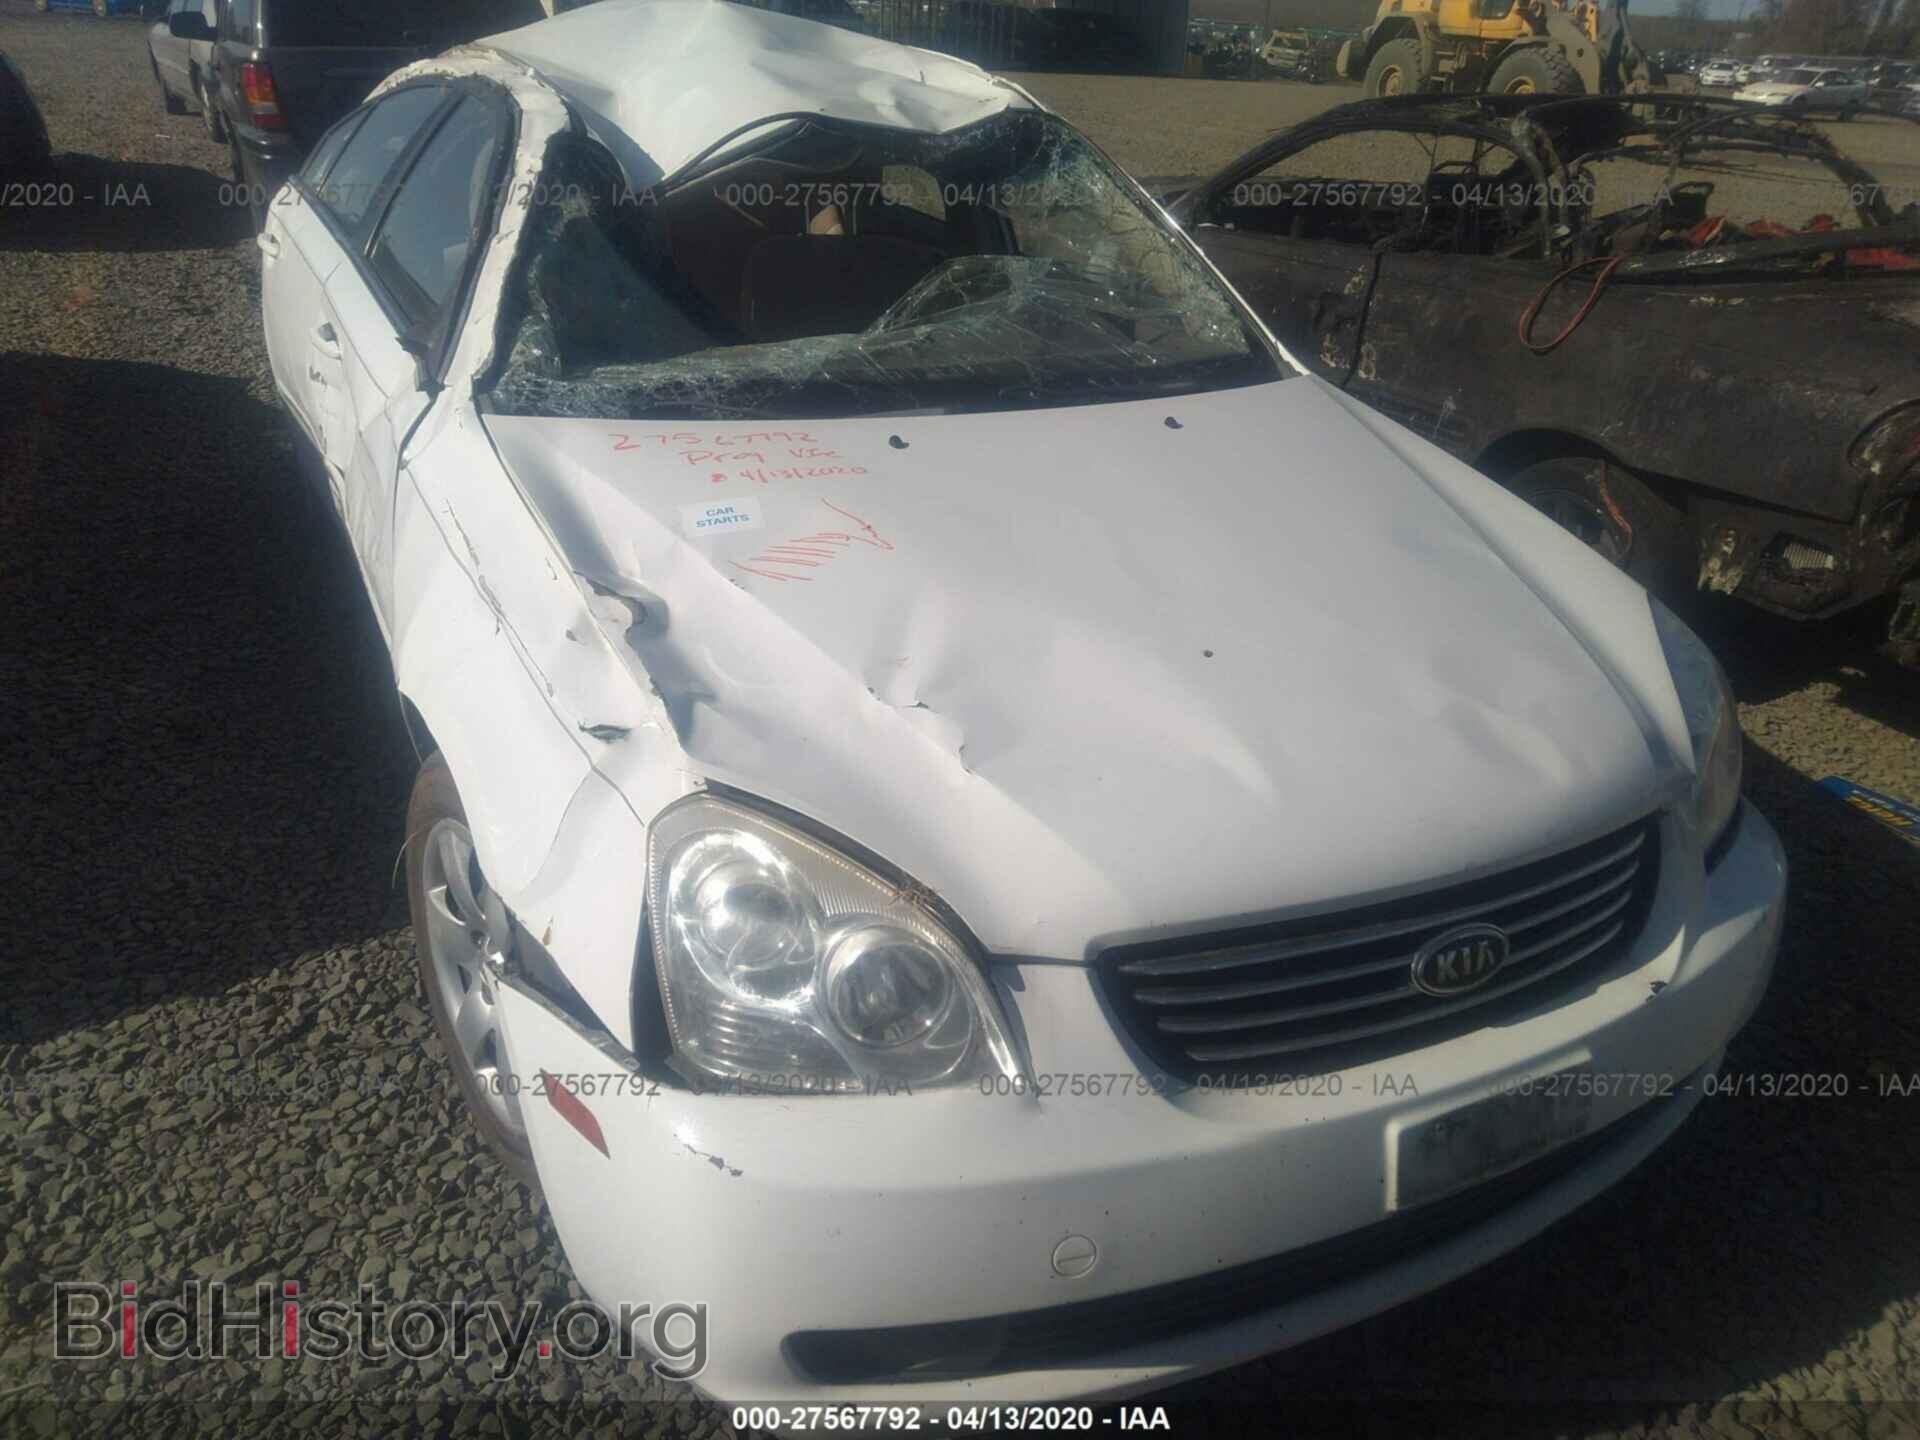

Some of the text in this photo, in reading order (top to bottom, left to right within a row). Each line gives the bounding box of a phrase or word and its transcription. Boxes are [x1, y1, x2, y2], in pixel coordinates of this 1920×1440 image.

[706, 506, 735, 518] CAR
[695, 514, 749, 528] STARTS
[1437, 941, 1496, 981] KIA
